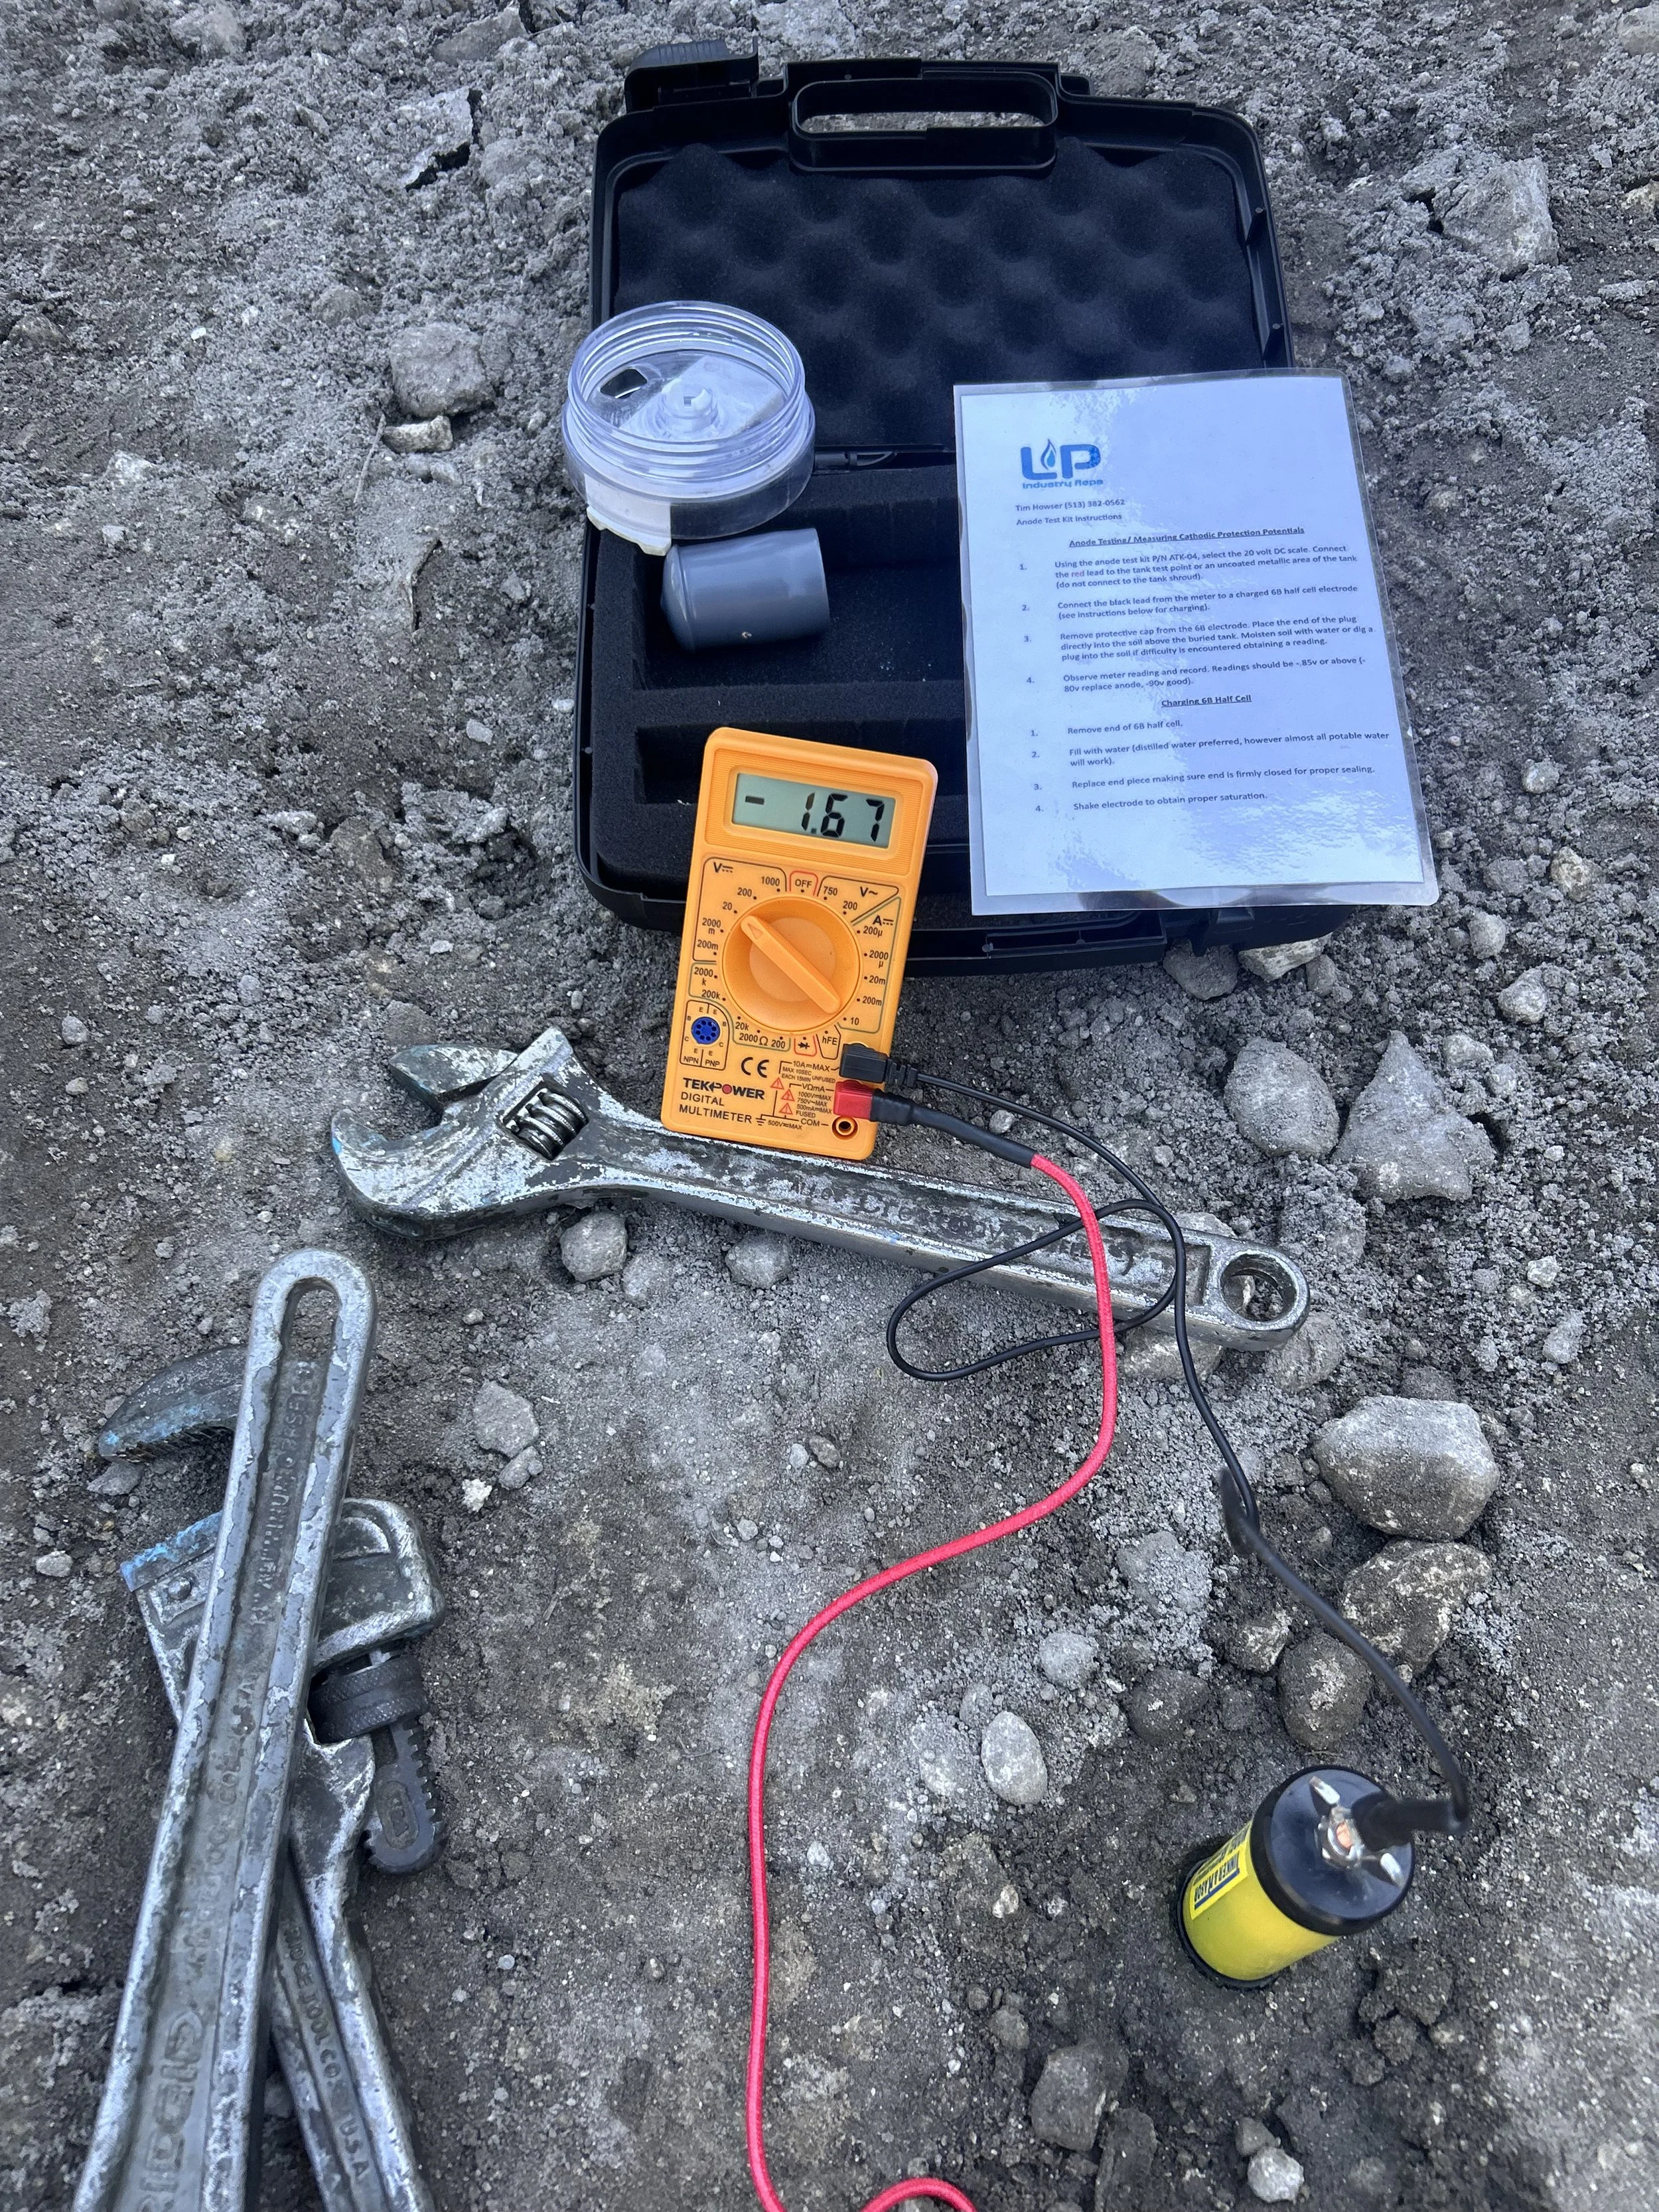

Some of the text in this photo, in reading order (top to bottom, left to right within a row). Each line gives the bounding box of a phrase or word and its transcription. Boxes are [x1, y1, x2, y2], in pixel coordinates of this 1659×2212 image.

[1022, 480, 1072, 489] Industry
[1087, 498, 1125, 507] 382-0562
[1074, 514, 1122, 523] Instructions
[1068, 527, 1304, 548] Anode Testing/ Measuring Cathodic Protection Potentials
[1235, 589, 1269, 598] charged
[1169, 603, 1210, 613] charging).
[1095, 630, 1137, 638] protective
[1207, 622, 1250, 630] electrode.
[1338, 615, 1357, 624] plug
[1161, 694, 1251, 708] Charging 6B Half Cell
[1072, 780, 1106, 788] Replace
[1126, 777, 1150, 786] piece
[1101, 799, 1143, 808] electrode
[761, 876, 780, 887] 1000
[795, 879, 812, 888] OFF
[737, 887, 752, 897] 200
[824, 886, 837, 896] 750
[723, 901, 732, 911] 20
[843, 901, 857, 911] 200
[697, 940, 718, 950] 200m
[869, 975, 885, 985] 20m
[701, 990, 720, 1000] 200k
[863, 996, 882, 1006] 200m
[735, 1022, 749, 1031] 20k
[739, 1033, 758, 1043] 2000
[771, 1040, 785, 1049] 200
[822, 1035, 837, 1045] hFE
[684, 1056, 699, 1065] NPN
[681, 1092, 724, 1106] DIGITAL
[680, 1104, 752, 1124] MULTIMETER
